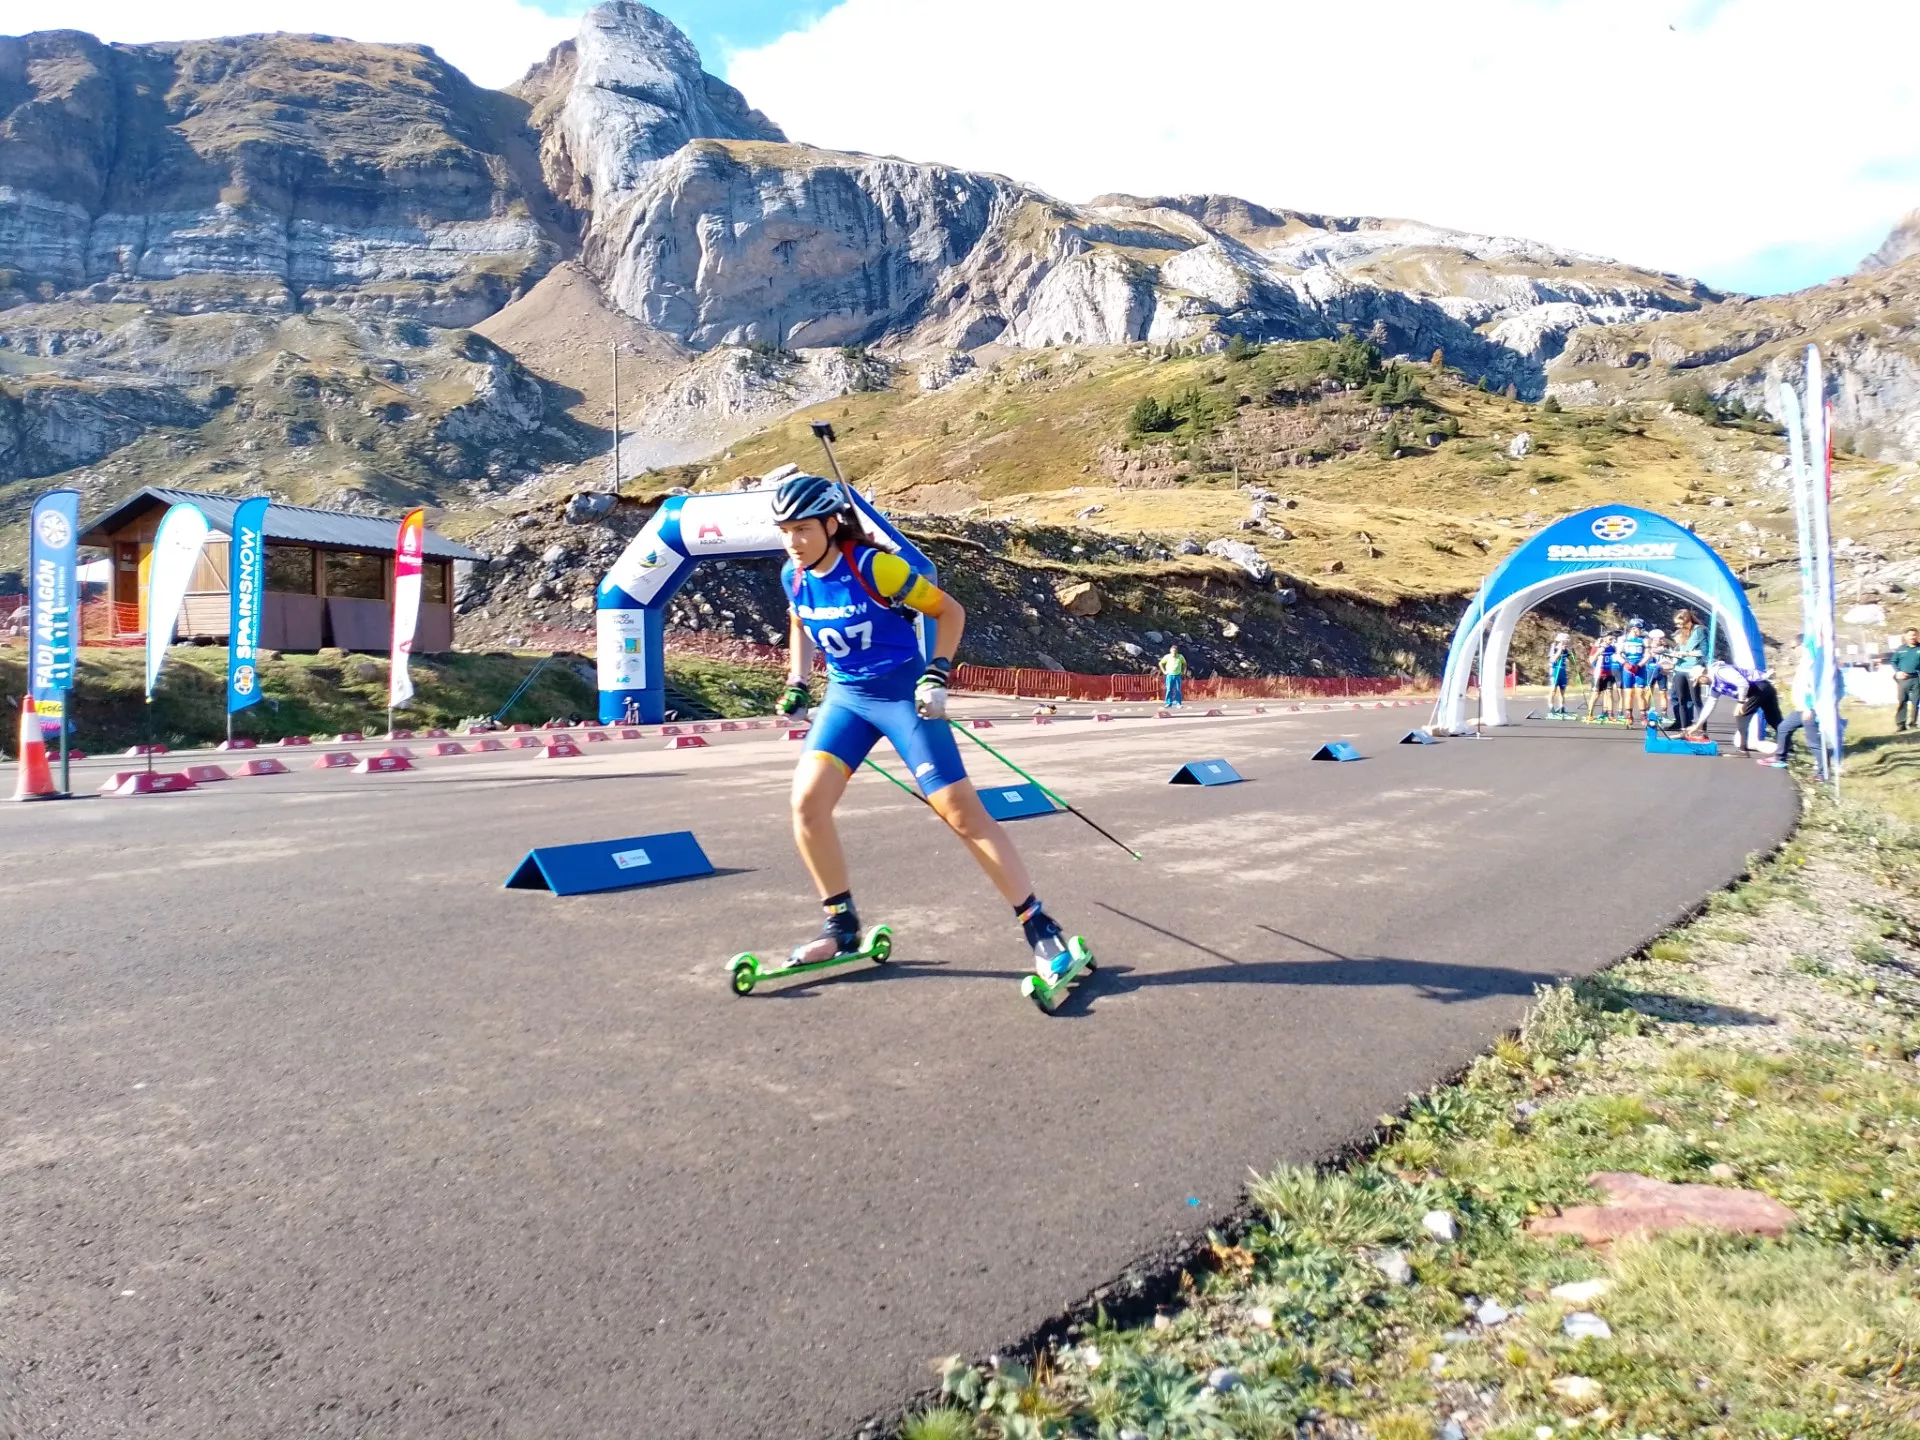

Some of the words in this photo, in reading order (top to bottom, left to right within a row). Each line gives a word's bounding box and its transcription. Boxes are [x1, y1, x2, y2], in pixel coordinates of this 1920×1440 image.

[1547, 542, 1677, 557] SPAINSNOW
[37, 559, 56, 641] ARAGÓN
[236, 526, 256, 659] SPAINSNOW
[36, 644, 55, 688] FADI
